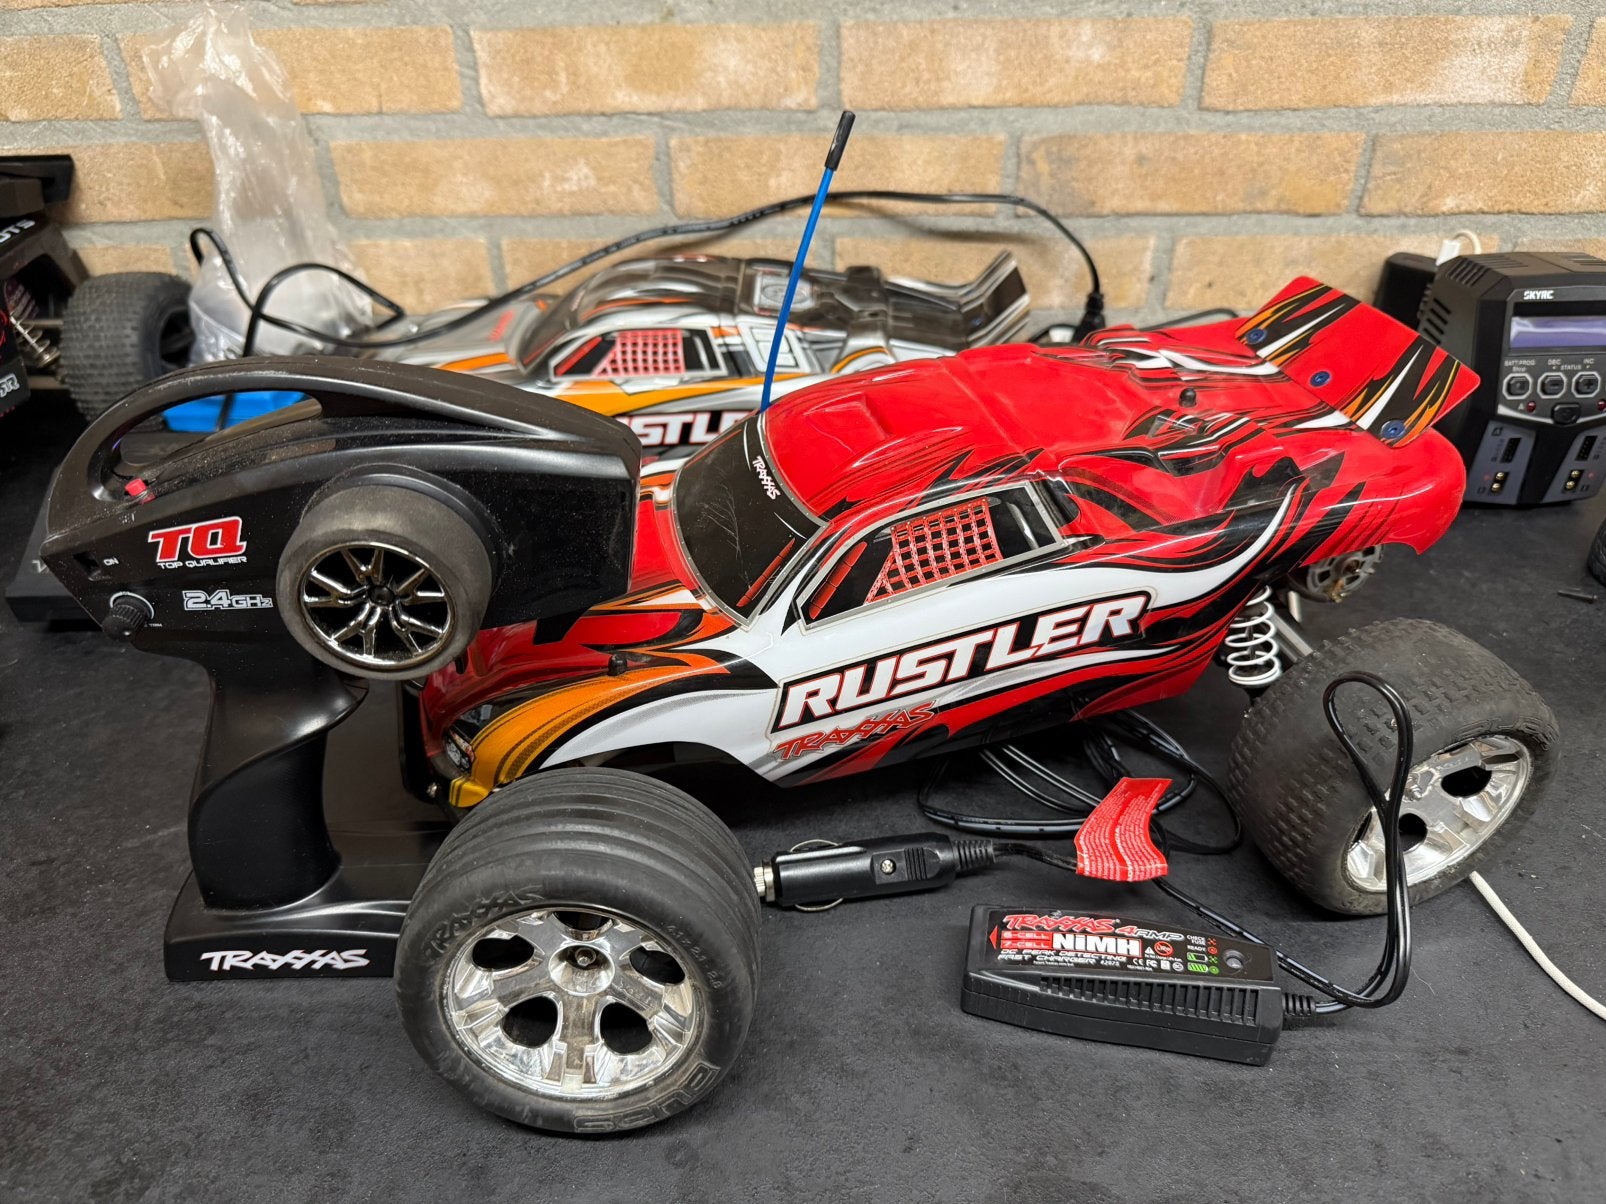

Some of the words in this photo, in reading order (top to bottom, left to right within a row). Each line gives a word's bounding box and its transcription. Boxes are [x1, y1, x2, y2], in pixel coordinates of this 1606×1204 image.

[1523, 289, 1555, 300] SKYRC
[752, 455, 781, 500] TRAXXAS
[148, 516, 247, 562] TQ
[103, 557, 120, 567] ON
[157, 561, 184, 570] TOP
[185, 556, 248, 568] QUALIFIER
[182, 590, 274, 611] 2.4GHz
[777, 593, 1148, 729] RUSTLER
[772, 700, 939, 761] TRAXXAS
[1002, 914, 1115, 933] TRAXXAS
[1052, 932, 1141, 957] NiMH
[200, 949, 370, 971] TRAXXAS
